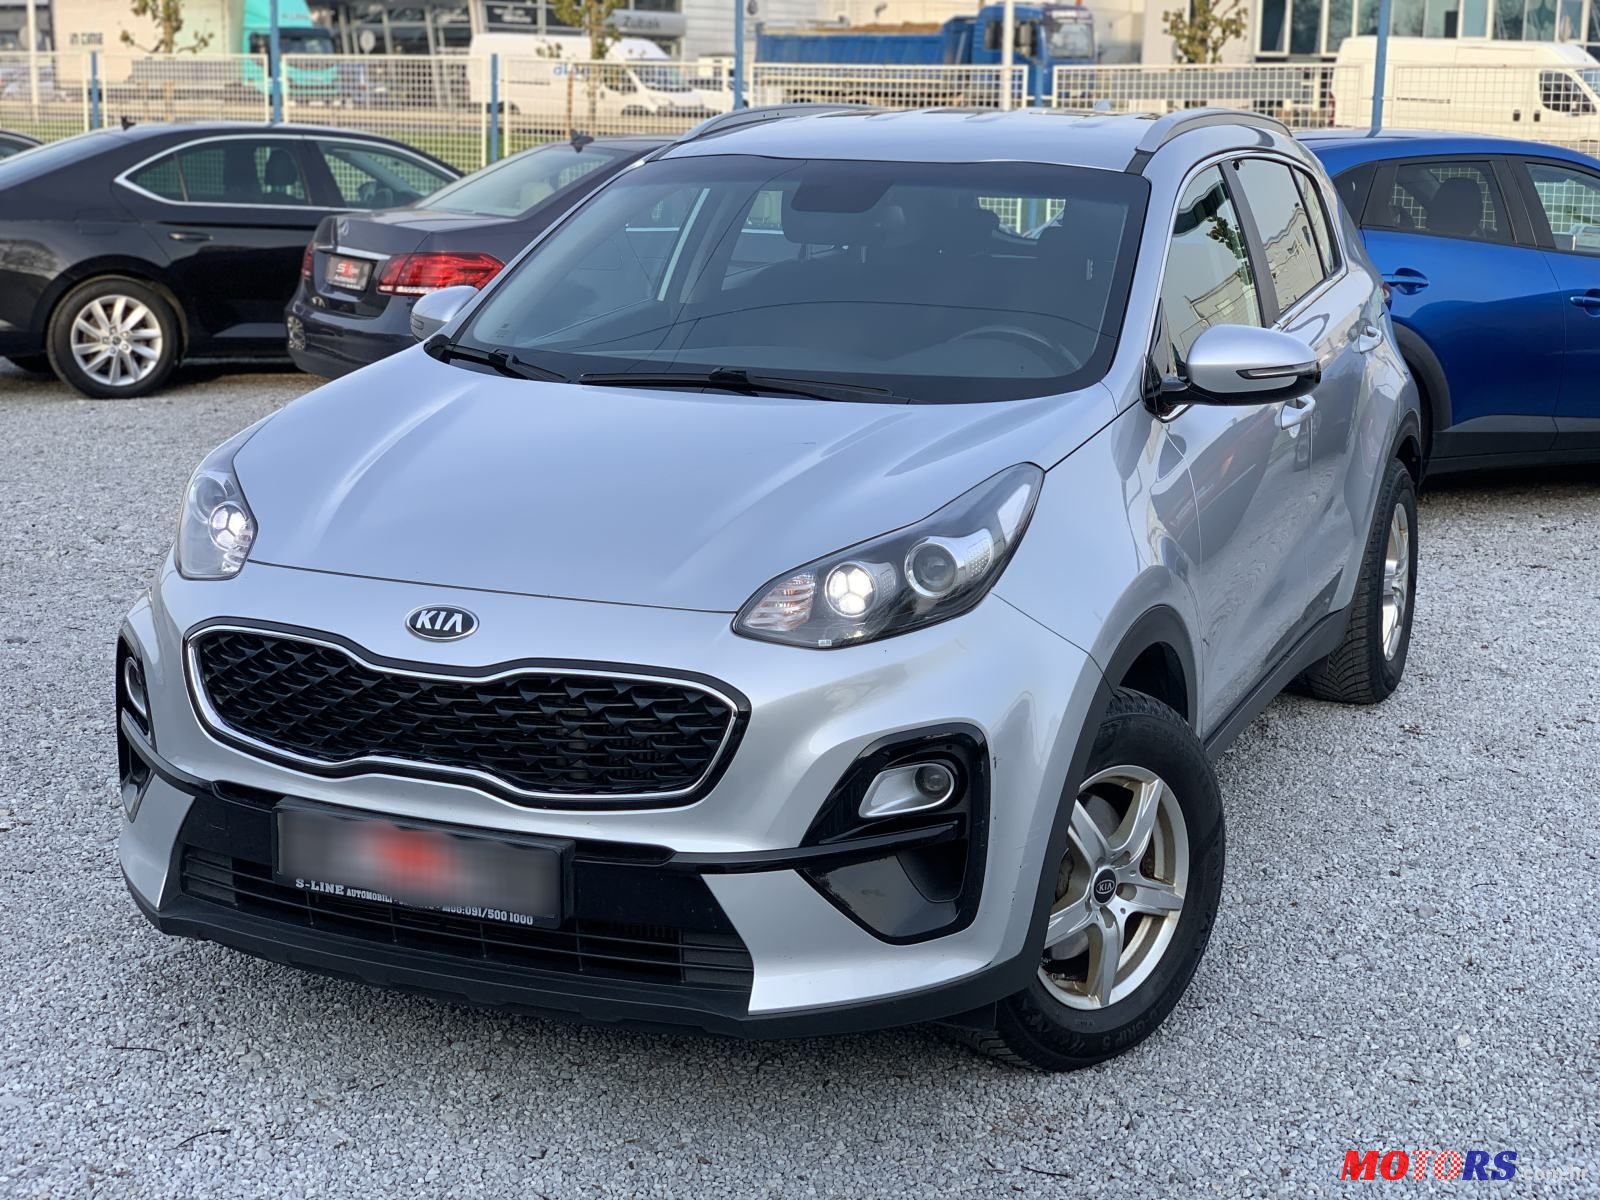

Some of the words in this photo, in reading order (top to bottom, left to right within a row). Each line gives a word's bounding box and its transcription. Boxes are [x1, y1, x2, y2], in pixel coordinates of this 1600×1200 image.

[416, 610, 463, 633] KIA
[295, 878, 345, 896] S-LINE
[509, 912, 534, 925] 1000
